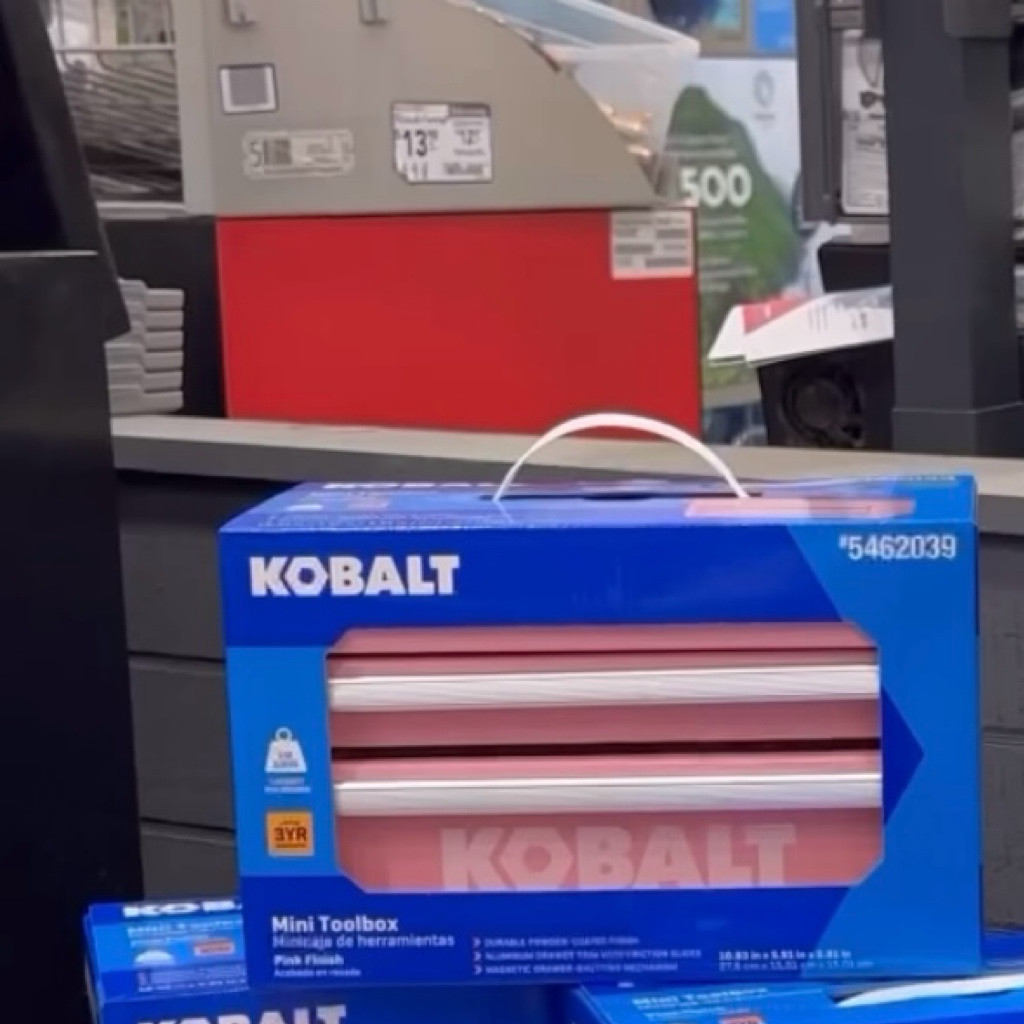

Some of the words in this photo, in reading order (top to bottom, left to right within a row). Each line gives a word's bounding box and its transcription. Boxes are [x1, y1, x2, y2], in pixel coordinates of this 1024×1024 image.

[679, 163, 753, 208] 500
[838, 532, 957, 562] #5462039
[248, 554, 461, 598] KOBALT
[273, 826, 308, 842] 3YR
[440, 823, 797, 891] KOBALT
[272, 915, 315, 933] Mini
[317, 914, 399, 933] Toolbox
[272, 933, 333, 950] Minicaja
[336, 933, 352, 949] de
[357, 932, 456, 948] herramientas
[273, 953, 301, 967] Pink
[303, 953, 345, 967] Finish
